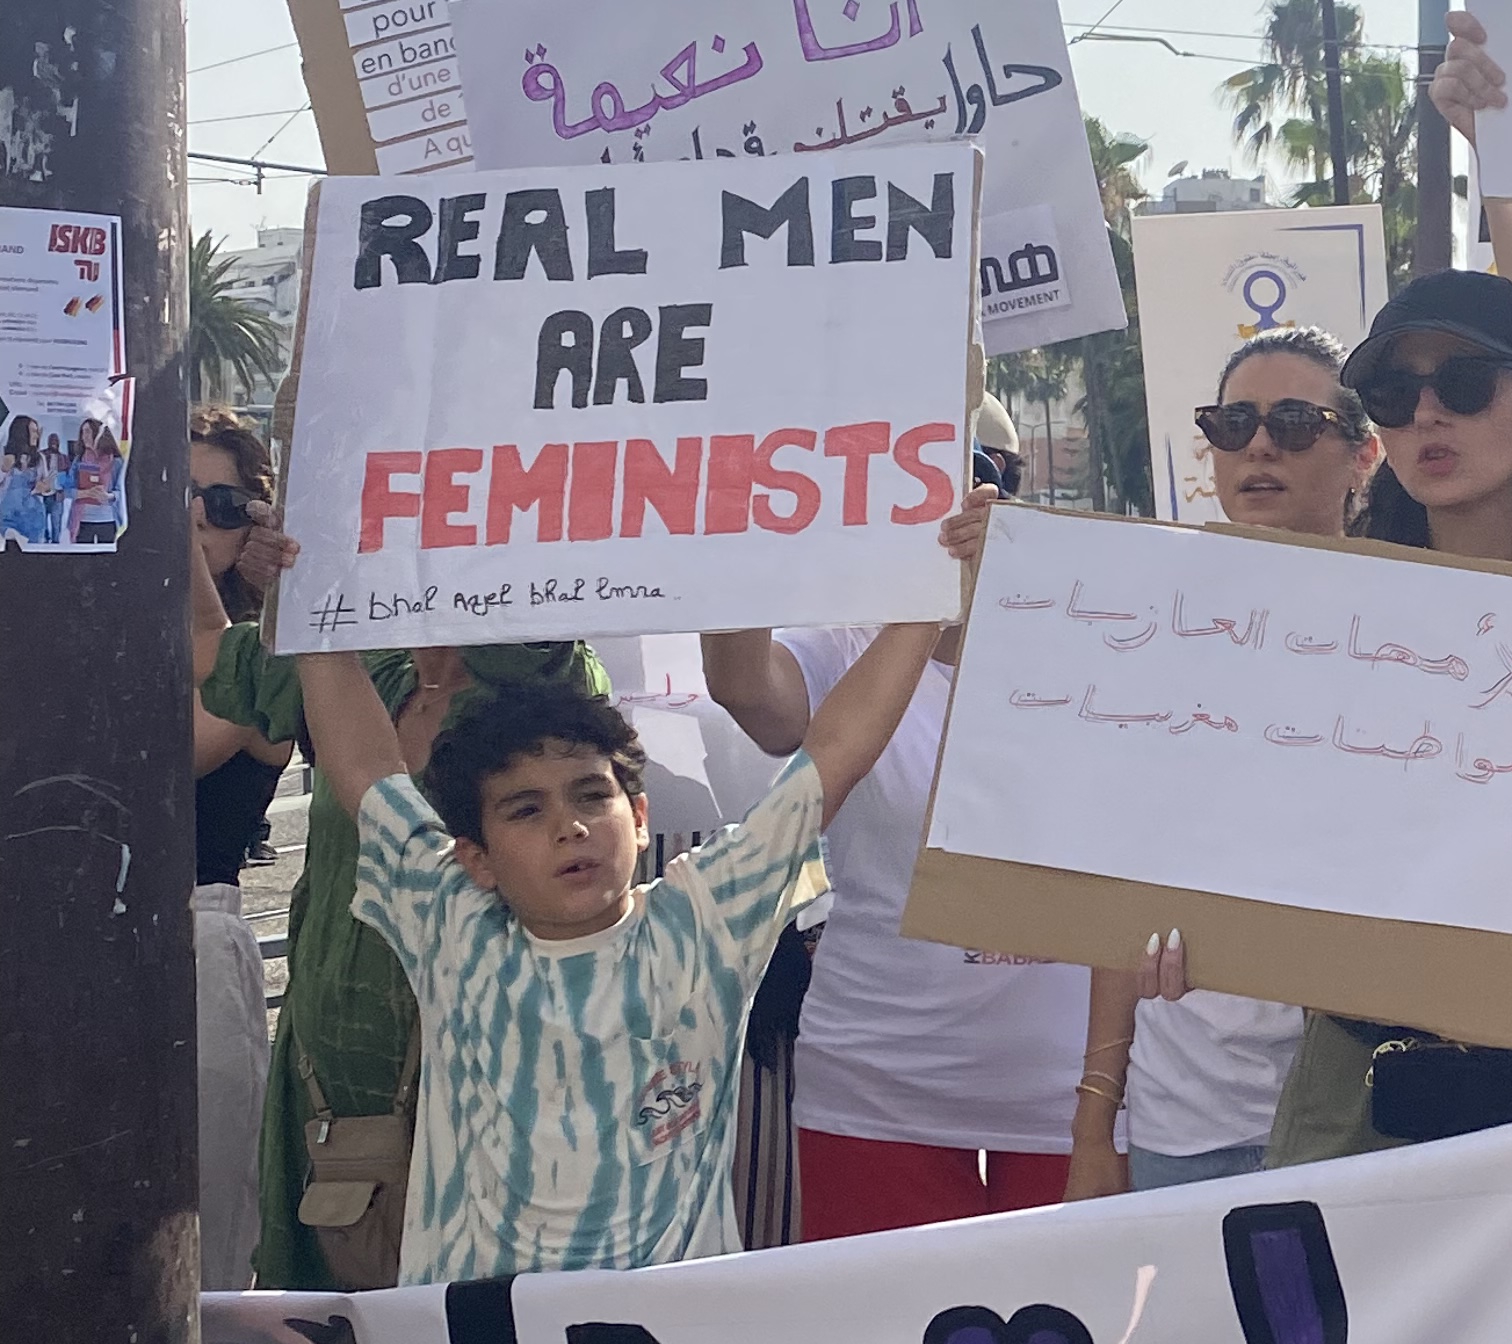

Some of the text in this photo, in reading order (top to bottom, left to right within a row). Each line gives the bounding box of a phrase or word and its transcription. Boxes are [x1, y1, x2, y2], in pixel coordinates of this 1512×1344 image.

[360, 52, 393, 77] en
[387, 65, 451, 98] d'une
[521, 33, 764, 141] نعيمة
[420, 100, 451, 125] de
[423, 136, 442, 161] A
[48, 223, 107, 256] ISKB
[353, 171, 956, 291] REAL MEN
[986, 289, 1061, 315] MOVEMENT
[532, 301, 714, 411] ARE
[355, 420, 958, 555] FEMINISTS
[1008, 683, 1240, 736] مغربيات
